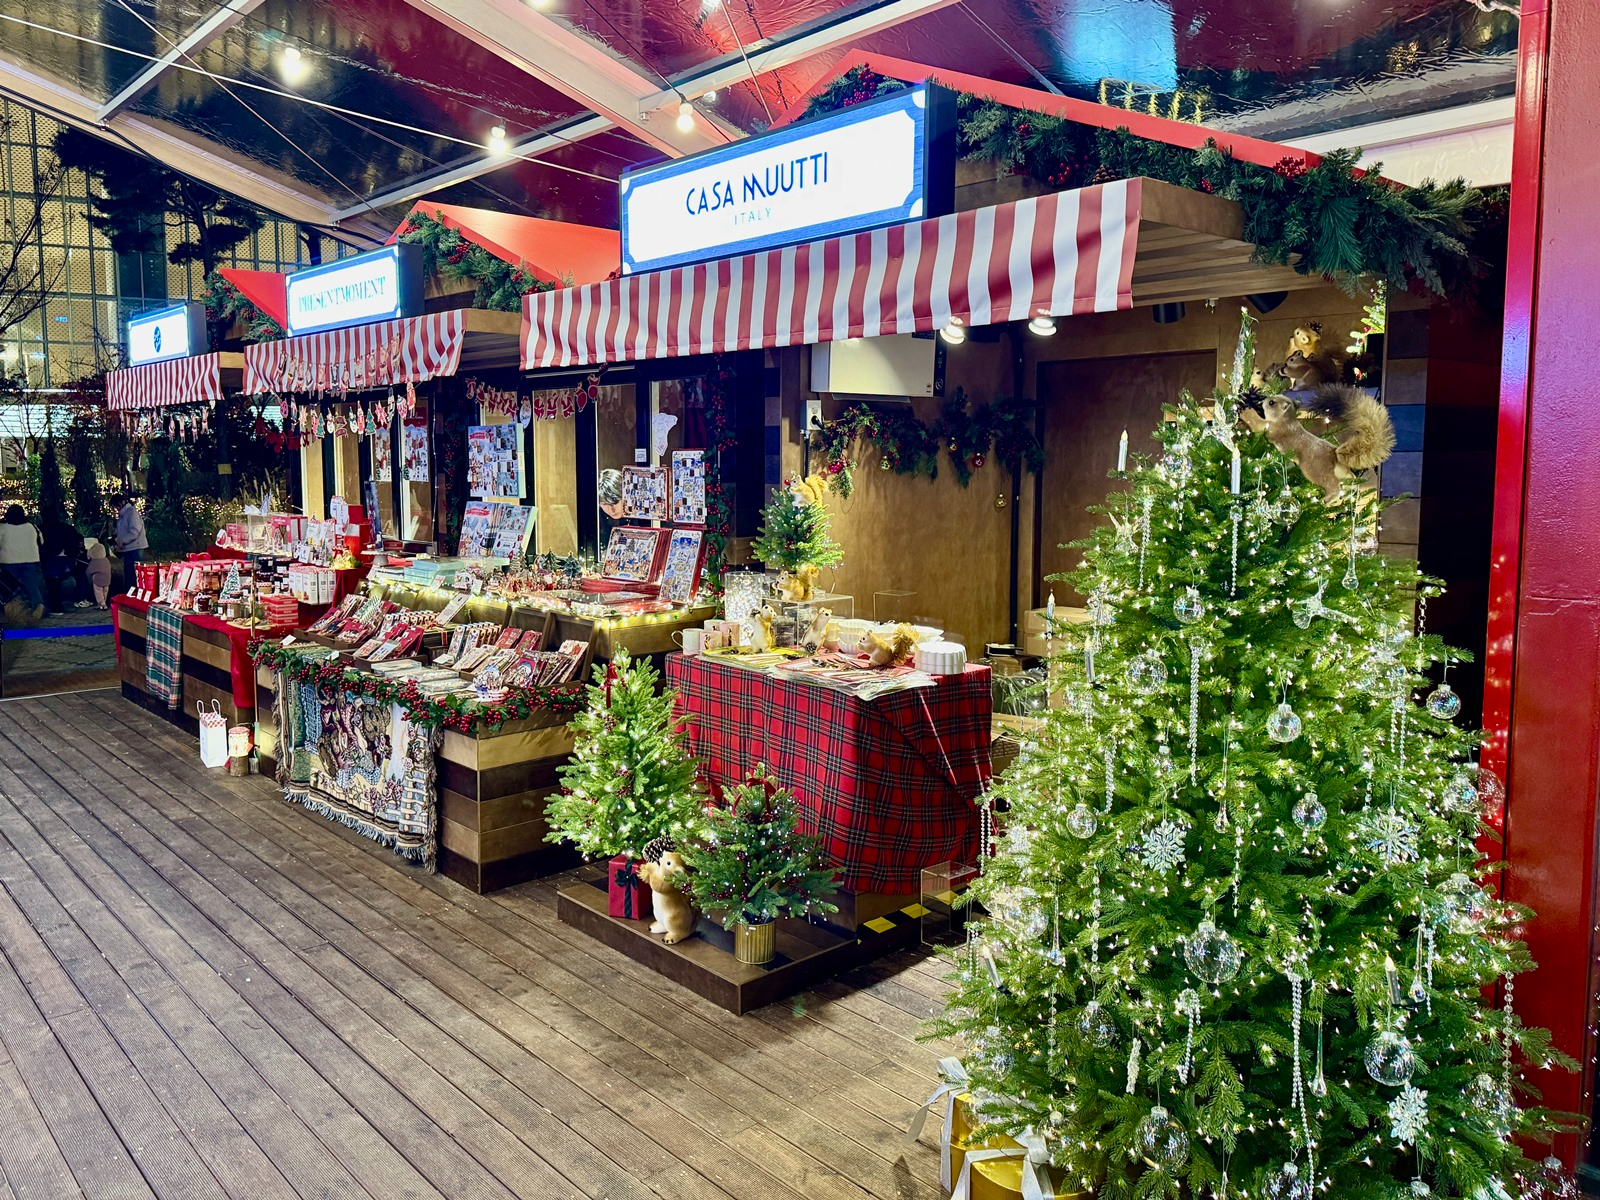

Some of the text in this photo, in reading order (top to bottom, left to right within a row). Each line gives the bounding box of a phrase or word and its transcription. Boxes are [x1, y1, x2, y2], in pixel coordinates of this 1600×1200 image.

[686, 151, 828, 215] CASA MUUTTI
[734, 207, 771, 225] ITALY
[298, 276, 386, 312] PRESENTMOMENT
